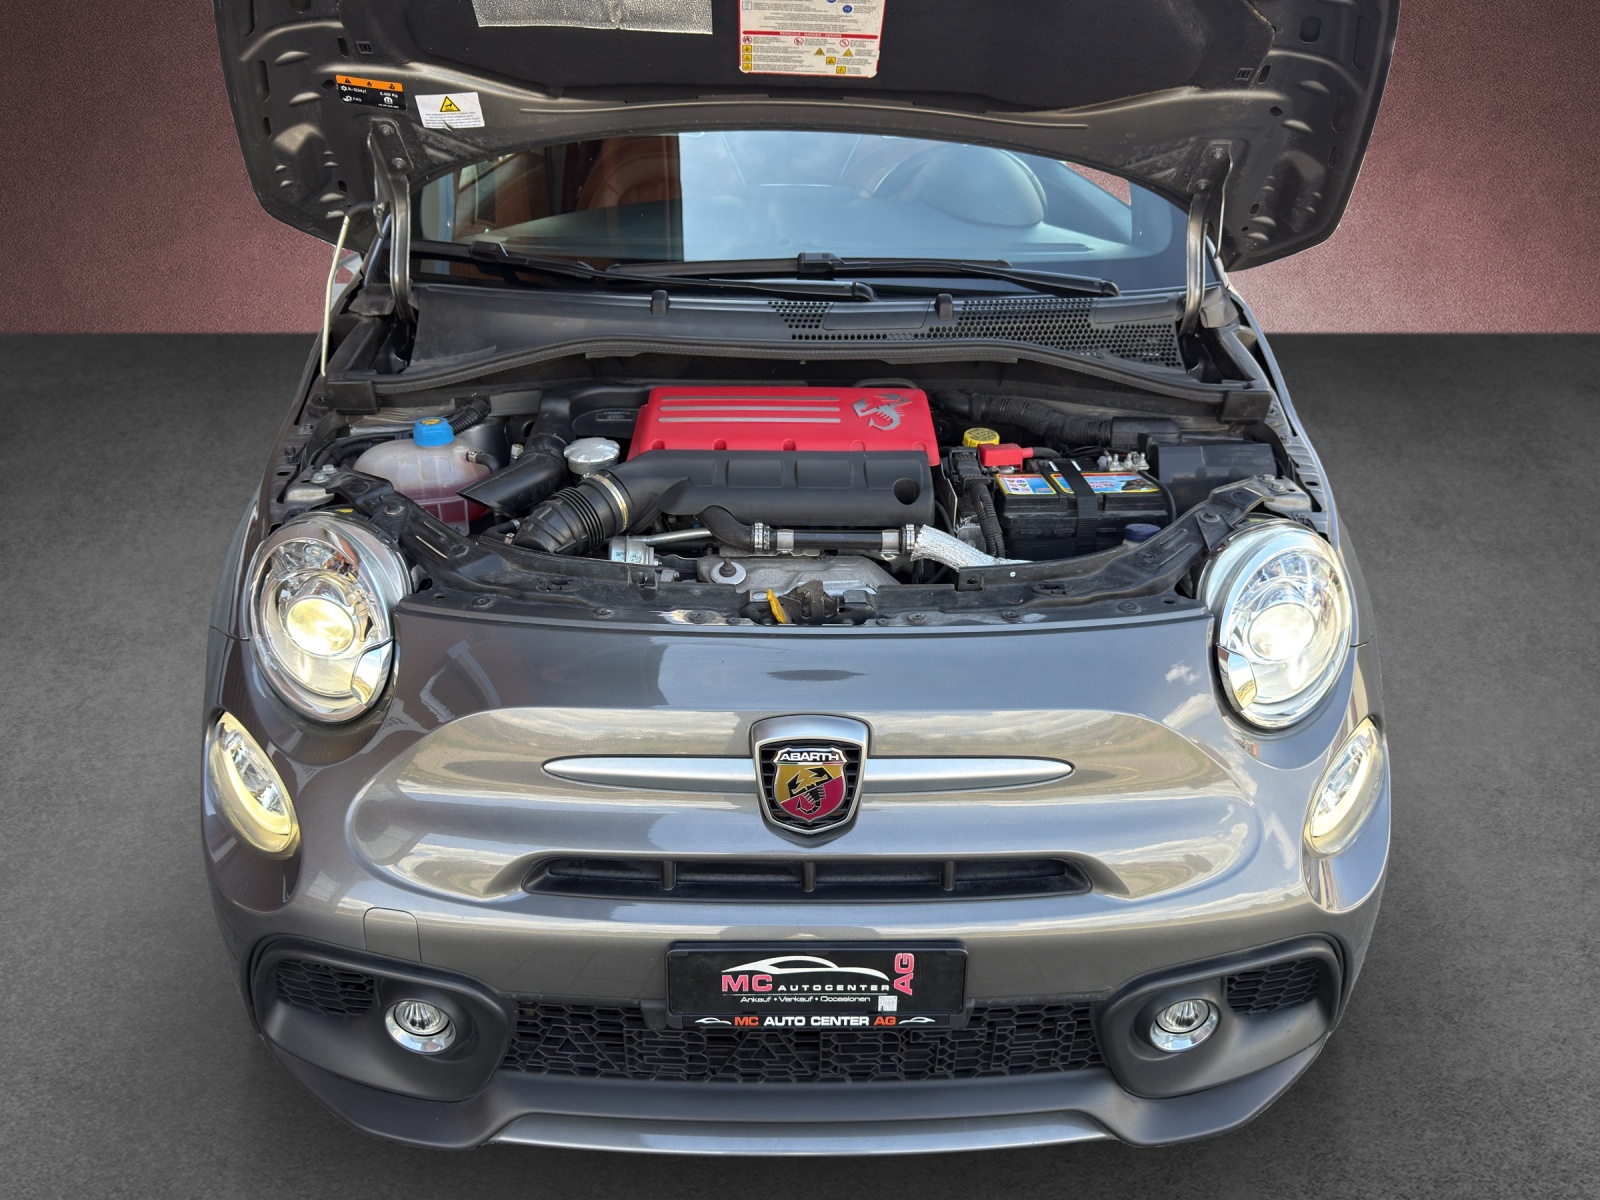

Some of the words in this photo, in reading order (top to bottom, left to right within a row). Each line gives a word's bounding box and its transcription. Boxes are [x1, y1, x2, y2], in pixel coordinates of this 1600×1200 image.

[780, 752, 839, 761] ABARTH
[893, 952, 915, 996] AG
[721, 974, 773, 992] MC
[779, 995, 814, 1003] Verkauf
[820, 995, 870, 1003] Occasionen
[734, 1016, 759, 1026] MC
[763, 1016, 805, 1026] AUTO
[810, 1016, 870, 1026] CENTER
[873, 1016, 897, 1026] AG
